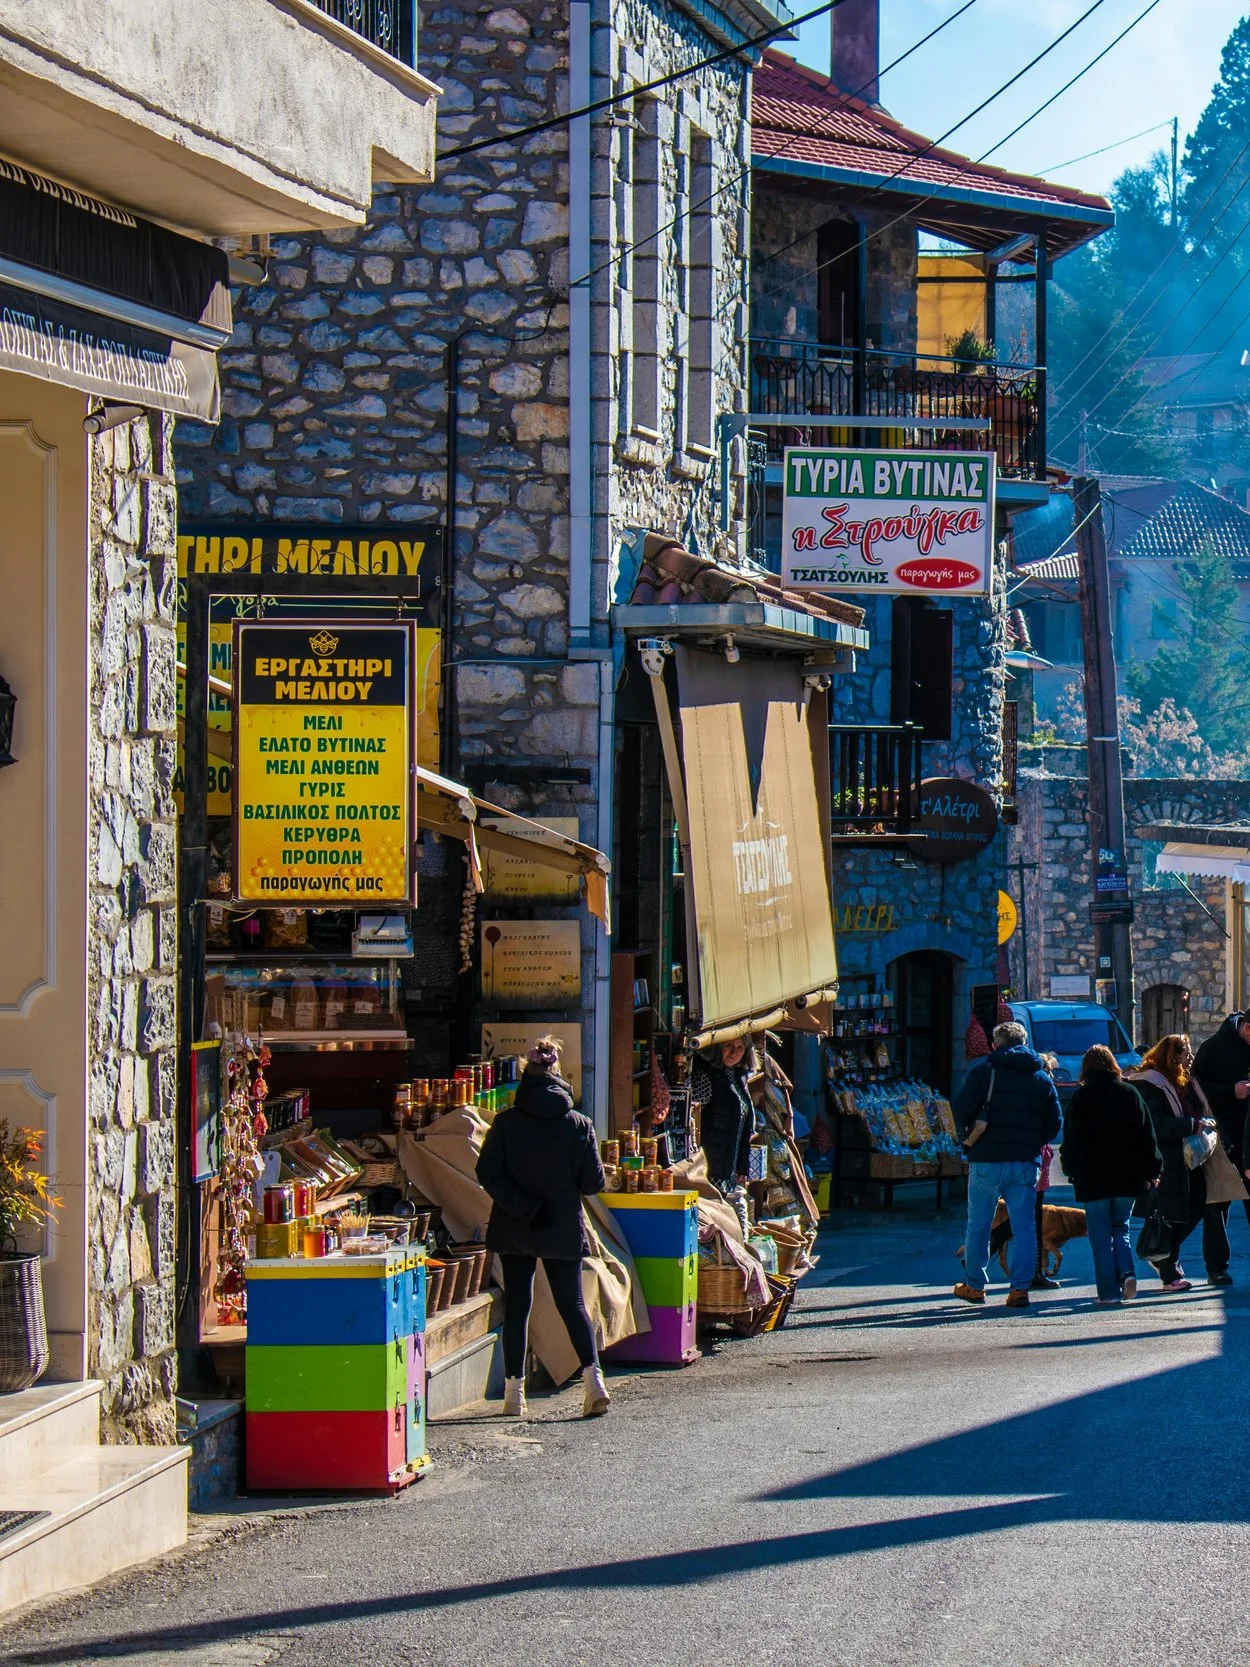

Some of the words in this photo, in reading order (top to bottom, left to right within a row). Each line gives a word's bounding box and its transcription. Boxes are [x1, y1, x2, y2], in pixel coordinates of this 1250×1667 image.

[791, 457, 865, 494] ΤΥΡΙΑ
[873, 459, 984, 498] ΒΥΤΙΝΑΣ
[820, 503, 985, 565] Στρούγκα
[177, 536, 263, 577] ΤΗΡΙ
[277, 537, 426, 576] ΜΕΛΙΟΥ
[790, 568, 889, 584] ΤΣΑΤΣΟΥΛΗΣ
[900, 568, 953, 583] παραγωγής
[957, 569, 975, 583] μας
[255, 658, 392, 677] ΕΡΓΑΣΤΗΡΙ
[275, 681, 373, 700] ΜΕΛΙΟΥ
[303, 715, 342, 730] ΜΕΛΙ
[259, 737, 312, 753] ΕΛΑΤΟ
[317, 737, 386, 753] ΒΥΤΙΝΑΣ
[266, 760, 305, 775] ΜΕΛΙ
[311, 760, 379, 775] ΑΝΘΕΩΝ
[299, 782, 346, 797] ΓΥΡΙΣ
[243, 804, 330, 820] ΒΑΣΙΛΙΚΟΣ
[335, 805, 401, 820] ΠΟΛΤΟΣ
[283, 827, 361, 842] ΚΕΡΥΘΡΑ
[282, 850, 362, 865] ΠΡΟΠΟΛΗ
[260, 874, 350, 892] παραγωγής
[355, 876, 384, 892] μας
